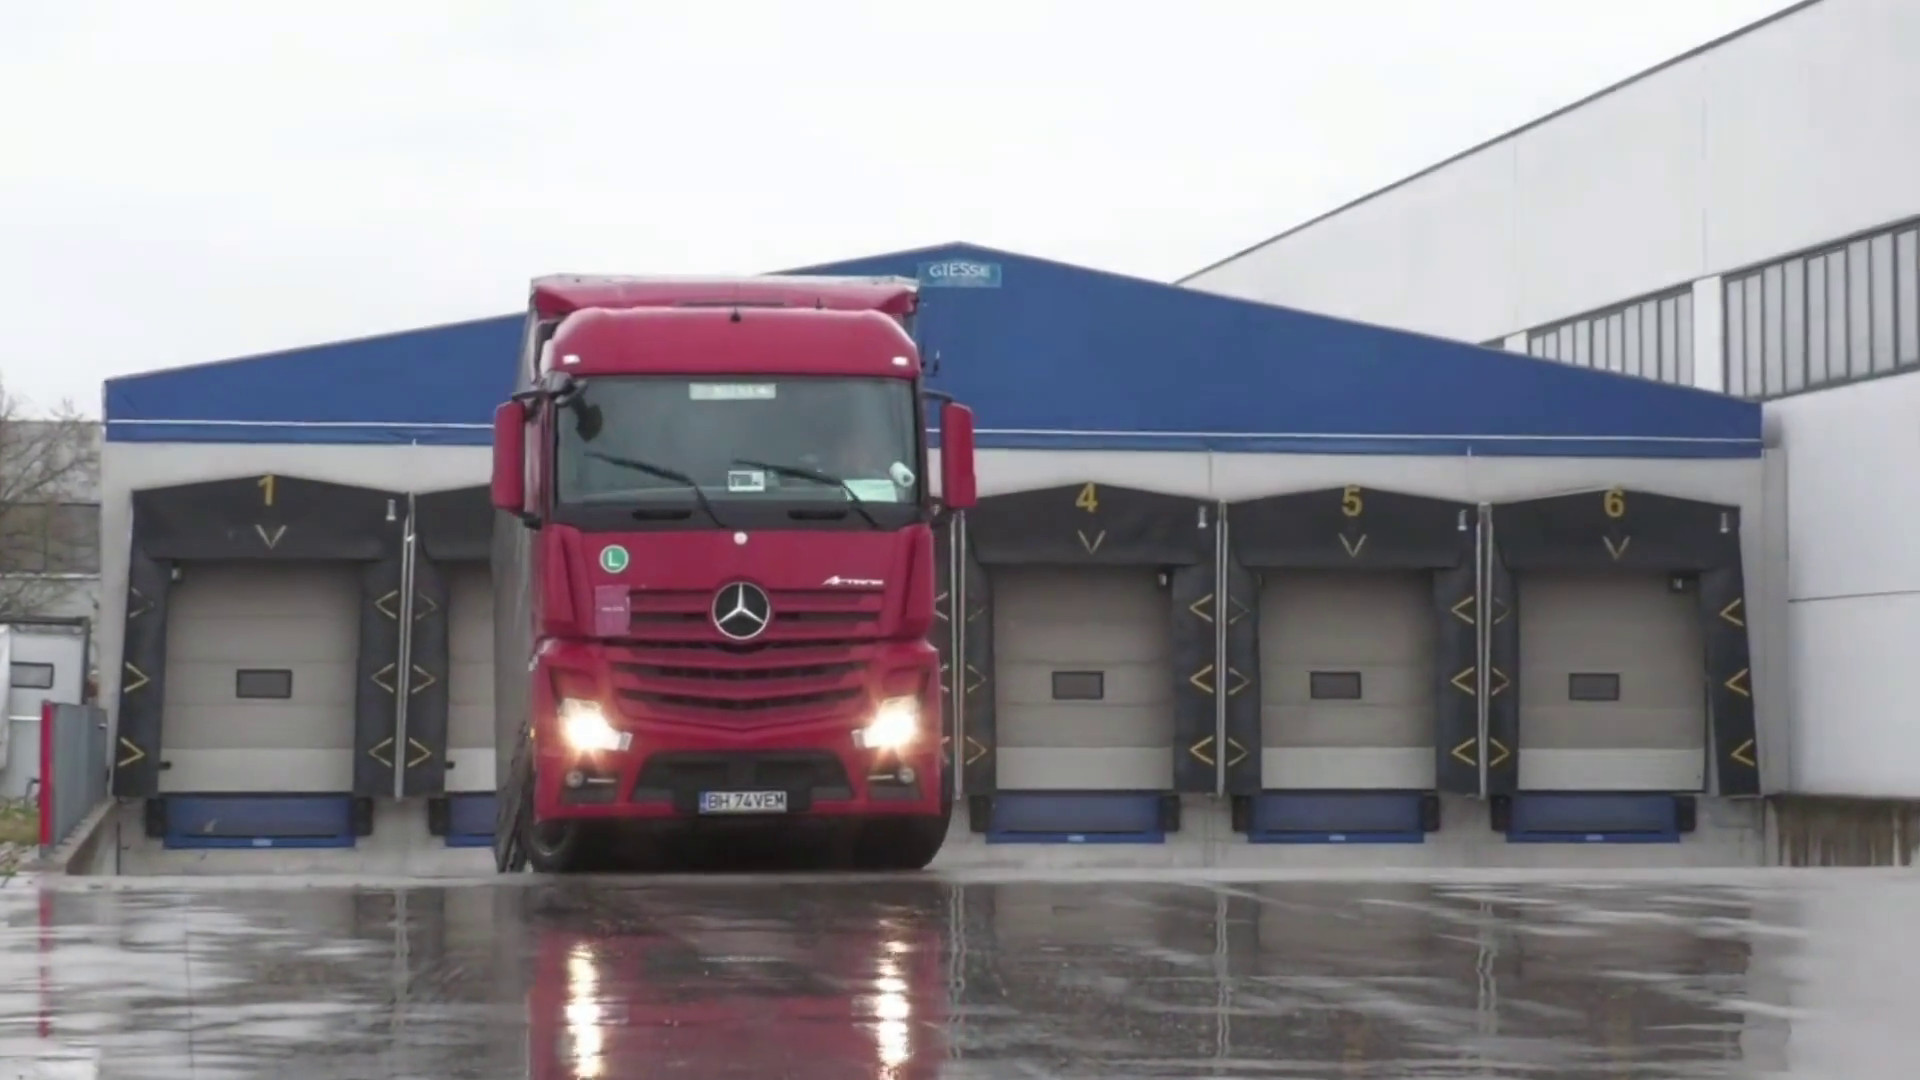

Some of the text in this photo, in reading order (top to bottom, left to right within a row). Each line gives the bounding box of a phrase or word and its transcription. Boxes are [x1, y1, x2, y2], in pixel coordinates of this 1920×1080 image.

[257, 474, 274, 506] 1
[1075, 481, 1098, 512] 4
[1342, 484, 1362, 516] 5
[1604, 487, 1624, 517] 6
[608, 551, 620, 567] L
